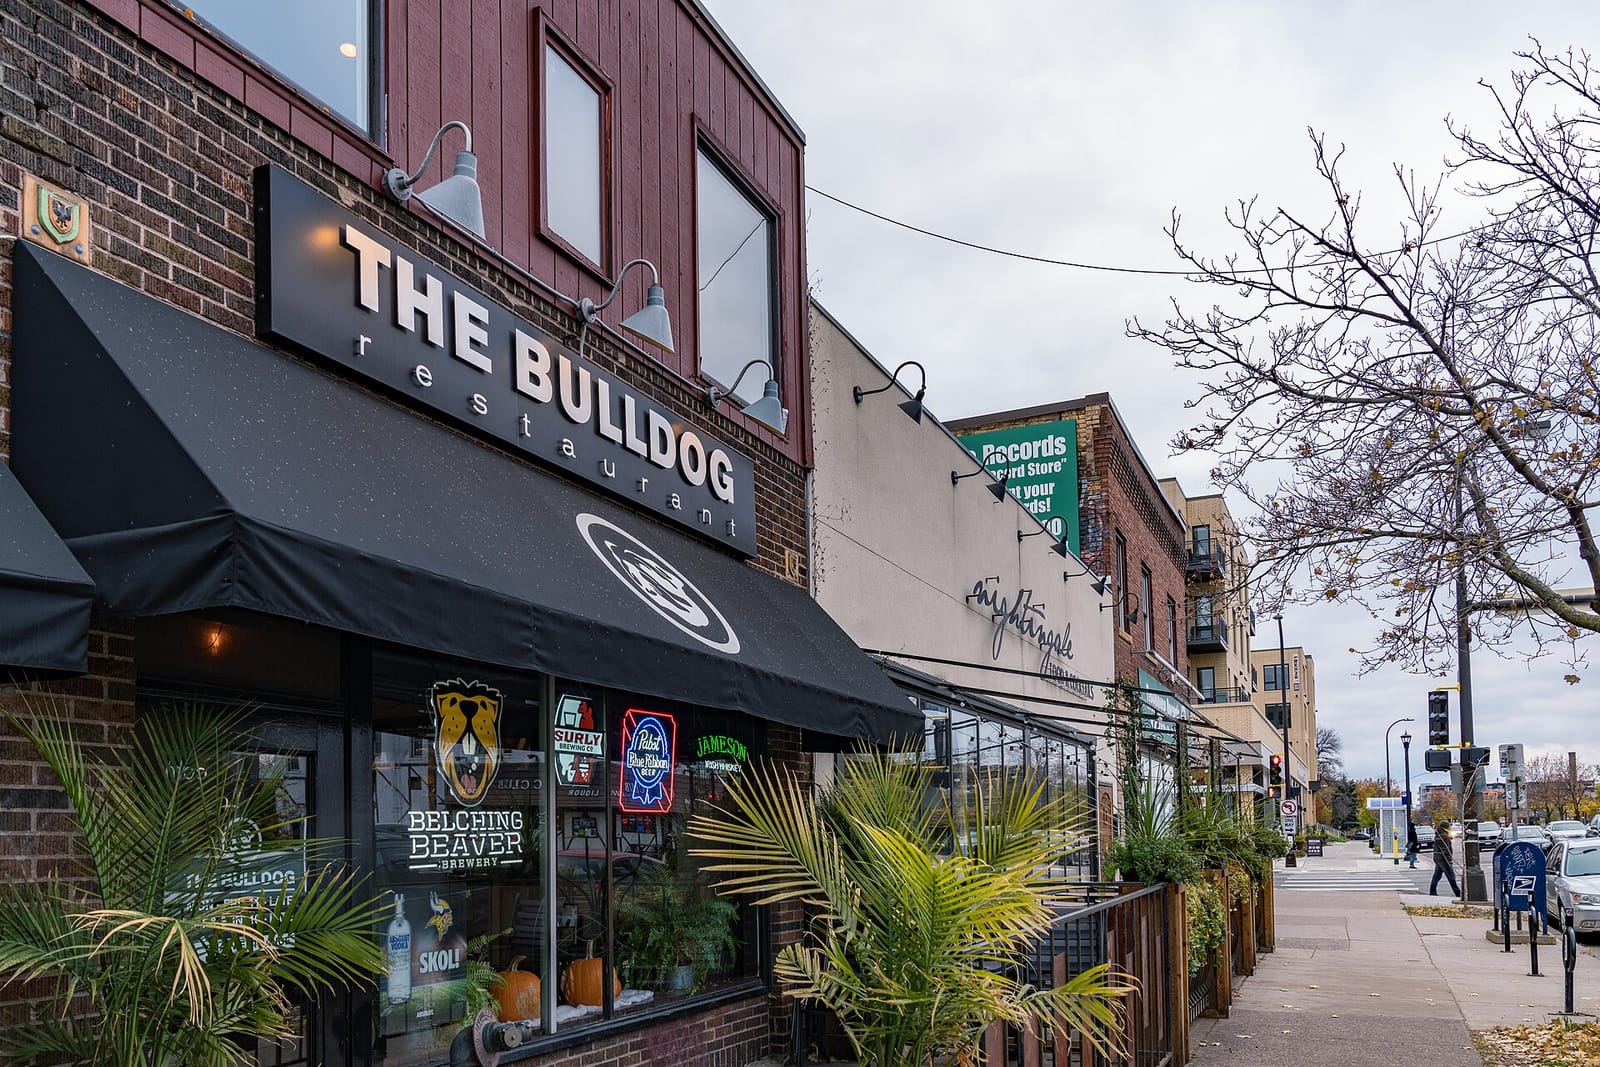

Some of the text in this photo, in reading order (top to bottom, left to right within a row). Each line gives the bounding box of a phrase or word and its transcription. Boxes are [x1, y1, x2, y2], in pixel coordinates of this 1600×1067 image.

[344, 223, 735, 505] THE BULLDOG
[355, 334, 737, 537] restaurant
[982, 434, 1067, 466] Records
[1027, 458, 1067, 477] Store"
[1023, 482, 1055, 500] your
[554, 730, 600, 746] SURLY
[560, 743, 585, 752] BREWING
[638, 729, 660, 751] Pabst
[697, 735, 747, 762] JAMESON
[629, 751, 668, 769] Blue Ribbon
[641, 768, 656, 776] BEER
[407, 811, 523, 831] BELCHING
[409, 832, 523, 859] BEAVER
[442, 857, 498, 869] BREWERY
[221, 870, 296, 888] BULLDOG
[391, 941, 409, 950] VODKA
[420, 948, 460, 974] SKOL!
